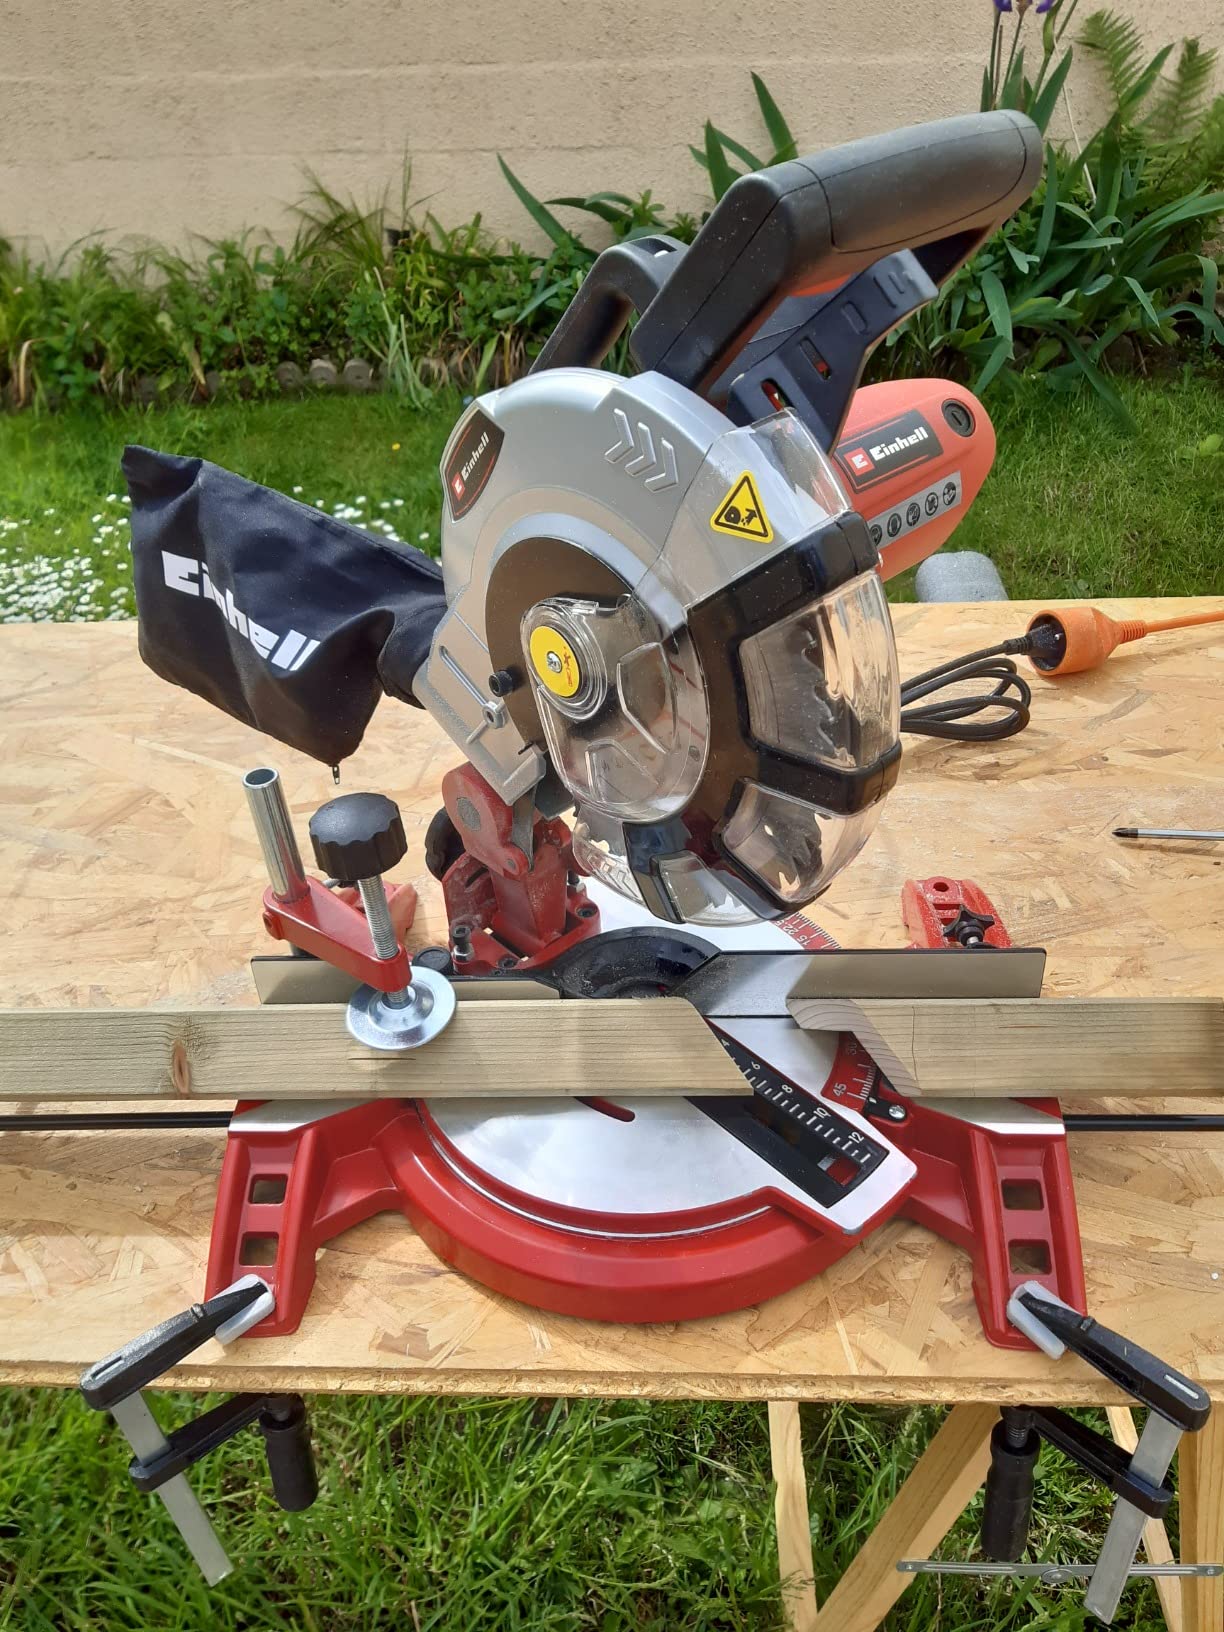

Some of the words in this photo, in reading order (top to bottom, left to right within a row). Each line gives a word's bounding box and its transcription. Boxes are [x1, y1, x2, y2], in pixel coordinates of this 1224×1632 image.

[869, 426, 929, 462] Einhell
[461, 432, 490, 481] Einhell
[161, 550, 321, 672] Einhell
[797, 934, 812, 946] 15
[751, 1061, 761, 1070] 6
[781, 1084, 793, 1094] 8
[833, 1083, 847, 1097] 45
[813, 1107, 832, 1119] 10
[848, 1131, 865, 1144] 12
